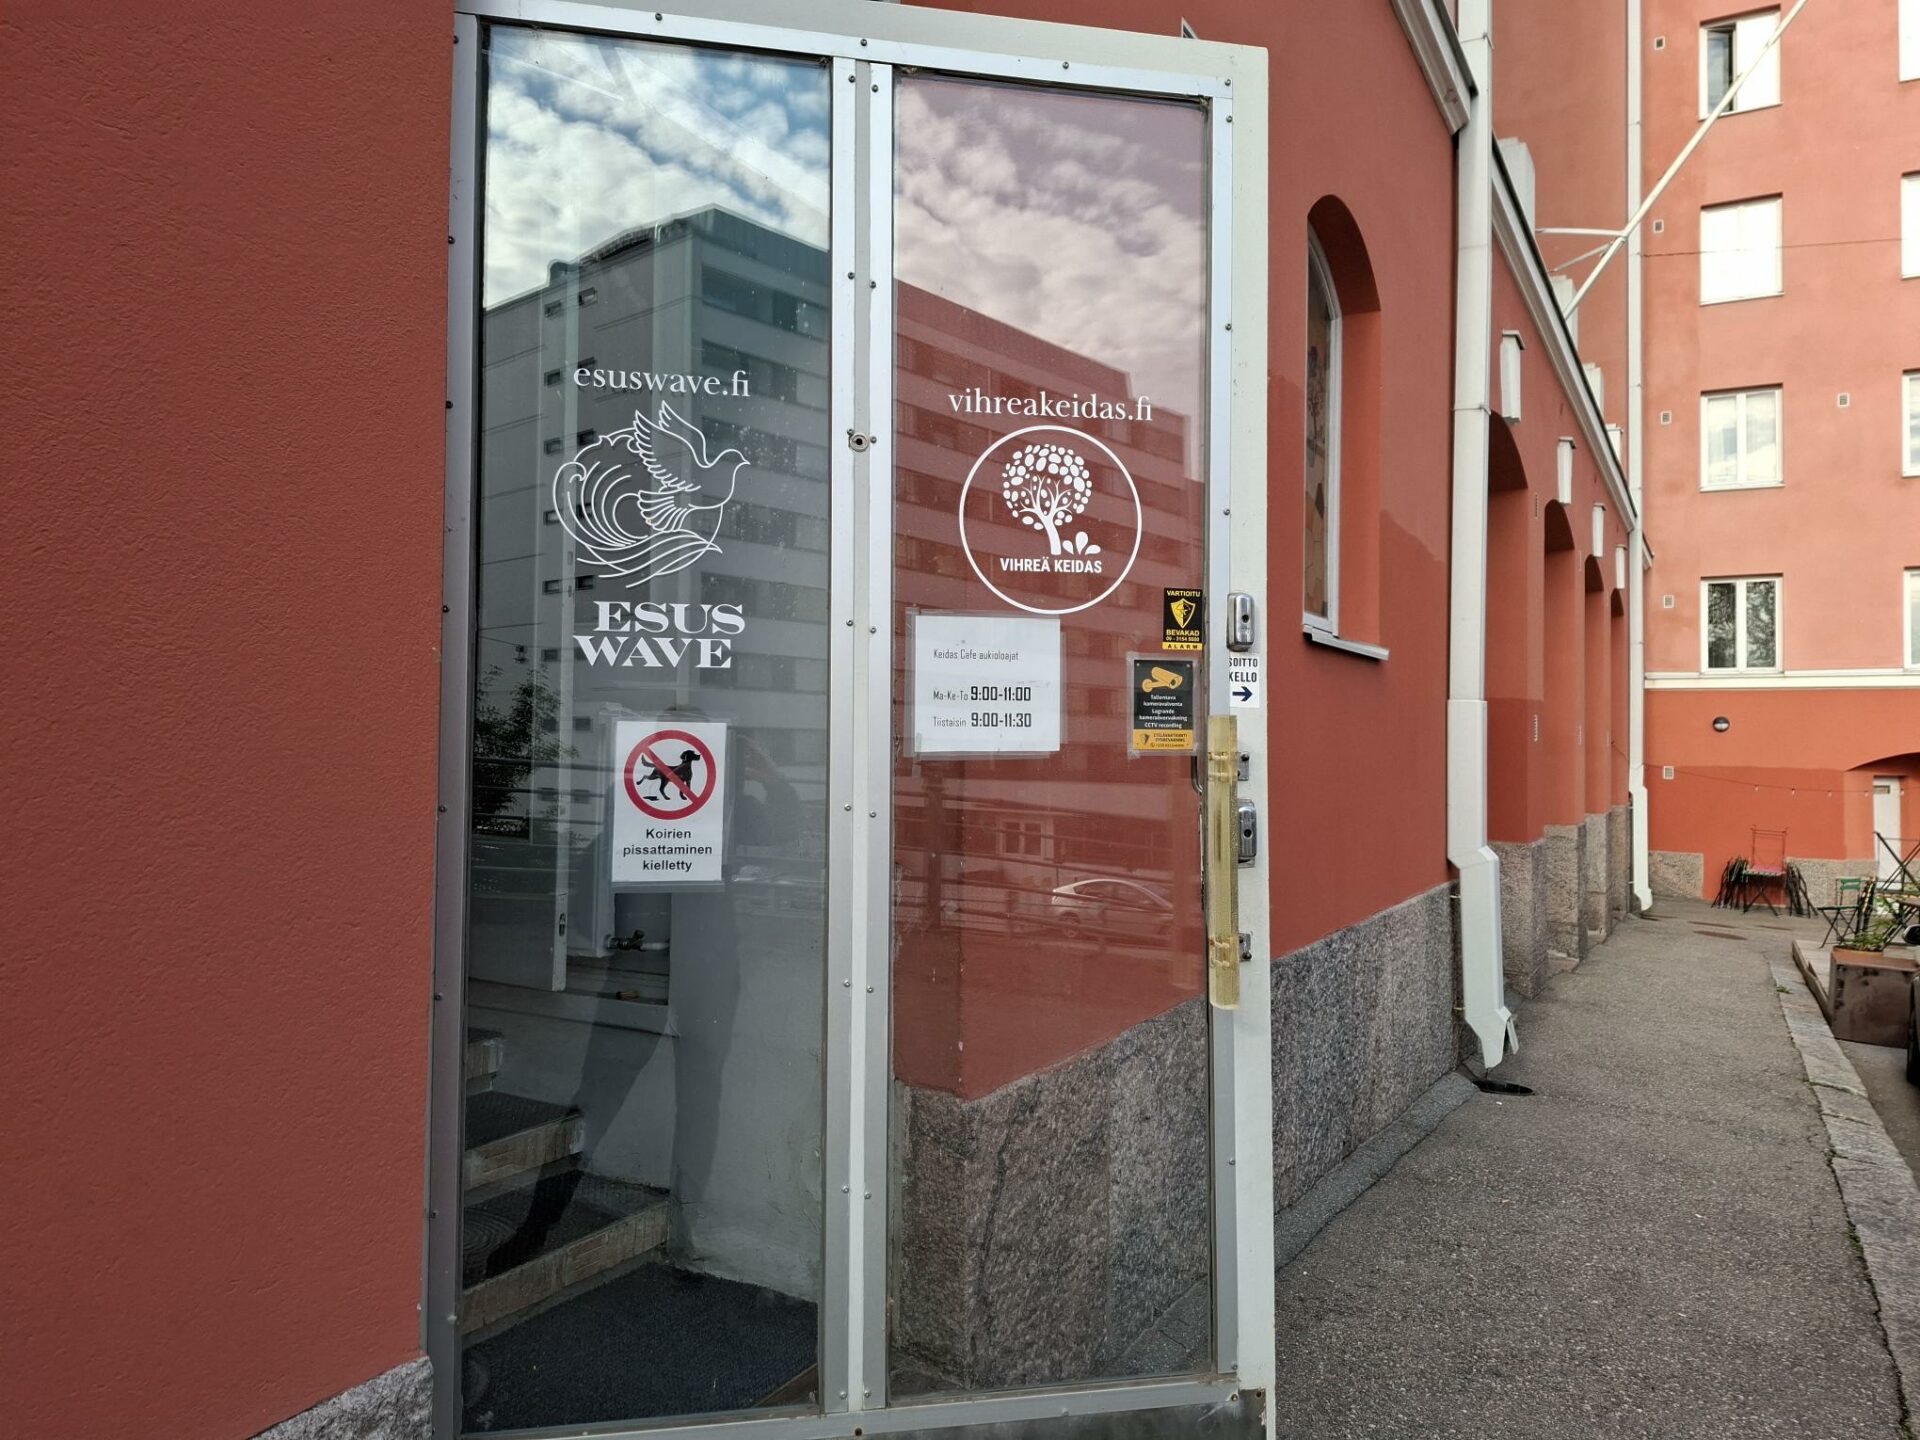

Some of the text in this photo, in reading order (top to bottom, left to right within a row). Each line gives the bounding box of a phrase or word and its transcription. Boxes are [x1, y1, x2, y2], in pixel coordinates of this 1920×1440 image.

[573, 367, 750, 397] esuswave.fi
[949, 387, 1153, 421] vihreakeidas.fi
[1000, 556, 1102, 573] VIHREÄ KEIDAS
[593, 600, 746, 635] ESUS
[572, 635, 732, 669] WAVE
[933, 648, 1019, 662] Keidas Cafe aukioloajat
[1229, 671, 1257, 683] KELLO
[970, 686, 1031, 702] 9:00-11:00
[933, 712, 1032, 728] Tiistaisin 9:00-11:30
[645, 828, 691, 839] Koirien
[623, 844, 713, 858] pissattaminen
[642, 860, 692, 873] kielletty
